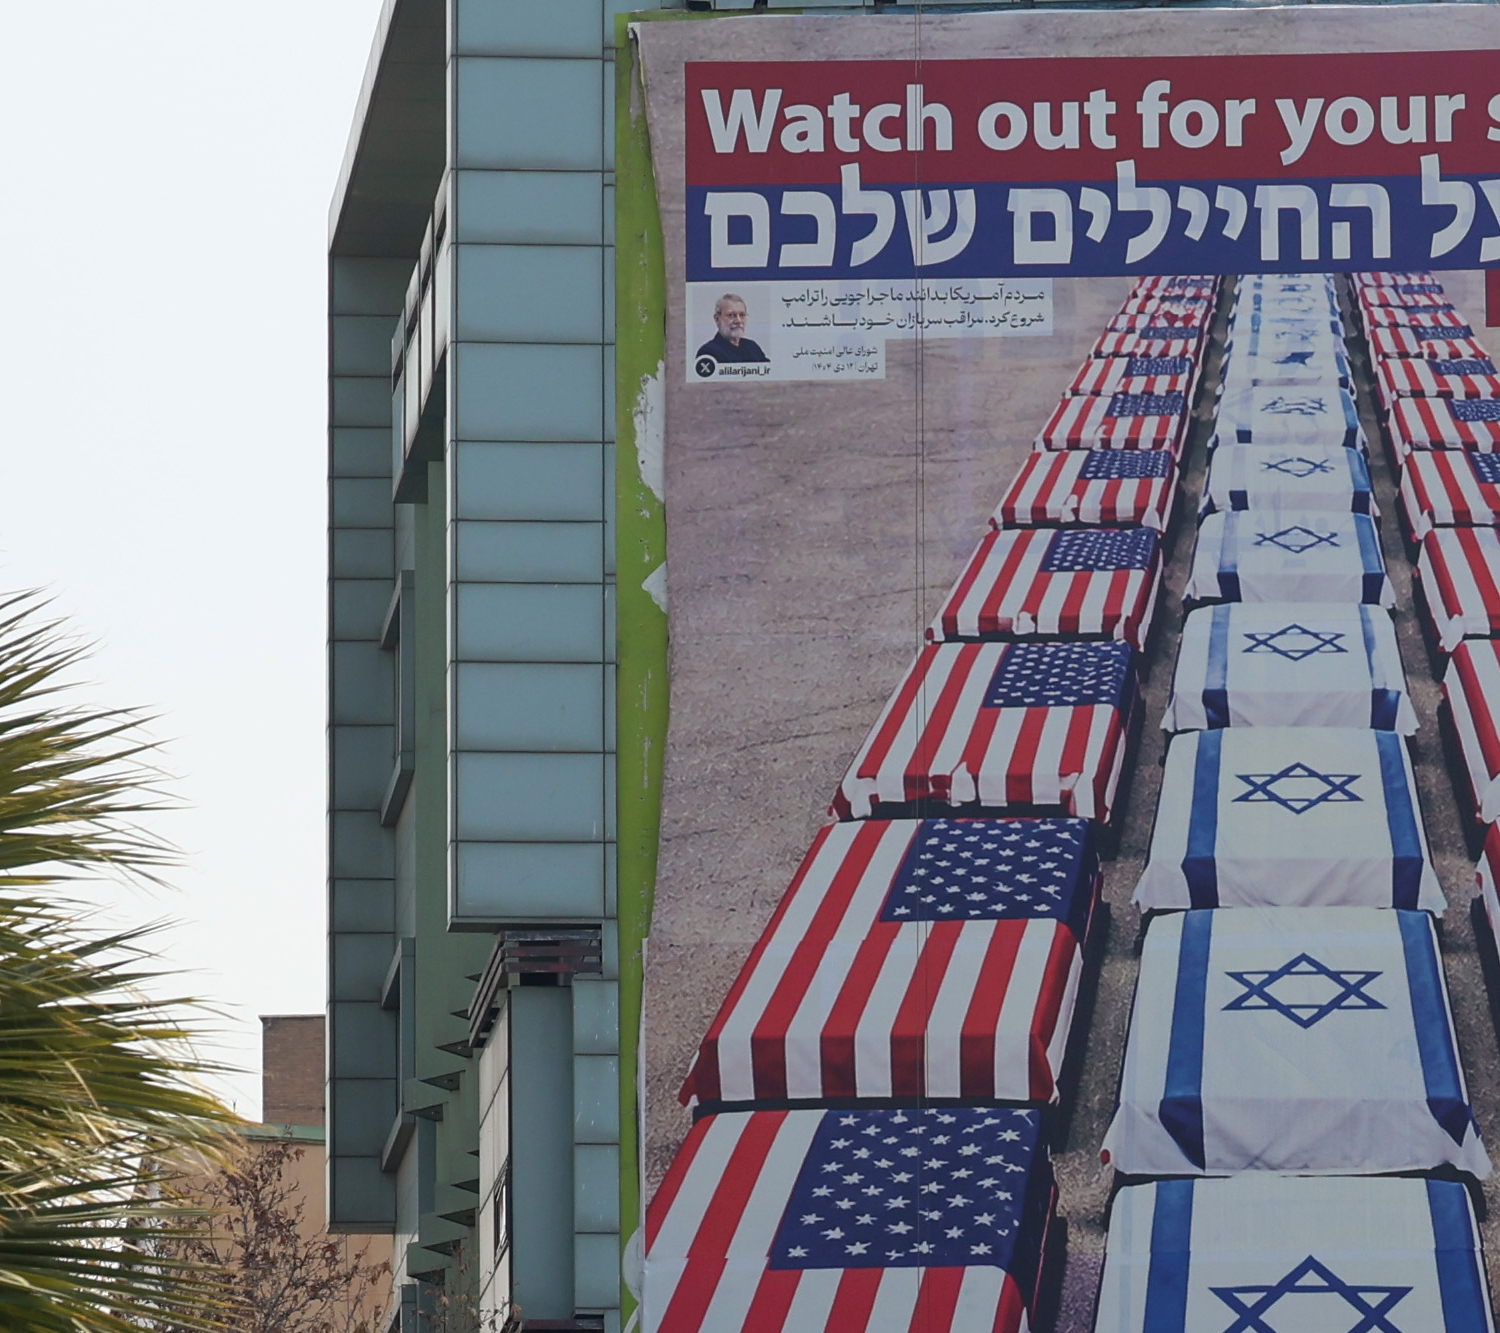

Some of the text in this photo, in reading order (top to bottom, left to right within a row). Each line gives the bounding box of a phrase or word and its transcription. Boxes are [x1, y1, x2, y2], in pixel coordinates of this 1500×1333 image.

[701, 87, 954, 155] Watch
[976, 88, 1116, 151] out
[1135, 78, 1257, 147] for
[1276, 92, 1466, 167] your
[706, 160, 976, 273] שלכם
[1009, 157, 1396, 270] החיילים
[781, 288, 819, 308] ترامپ
[950, 283, 1004, 304] آمریکا
[1004, 290, 1045, 307] مردم
[858, 312, 895, 330] خود
[896, 311, 943, 330] سربازان
[943, 311, 984, 329] مراقب
[1010, 312, 1045, 328] شروع
